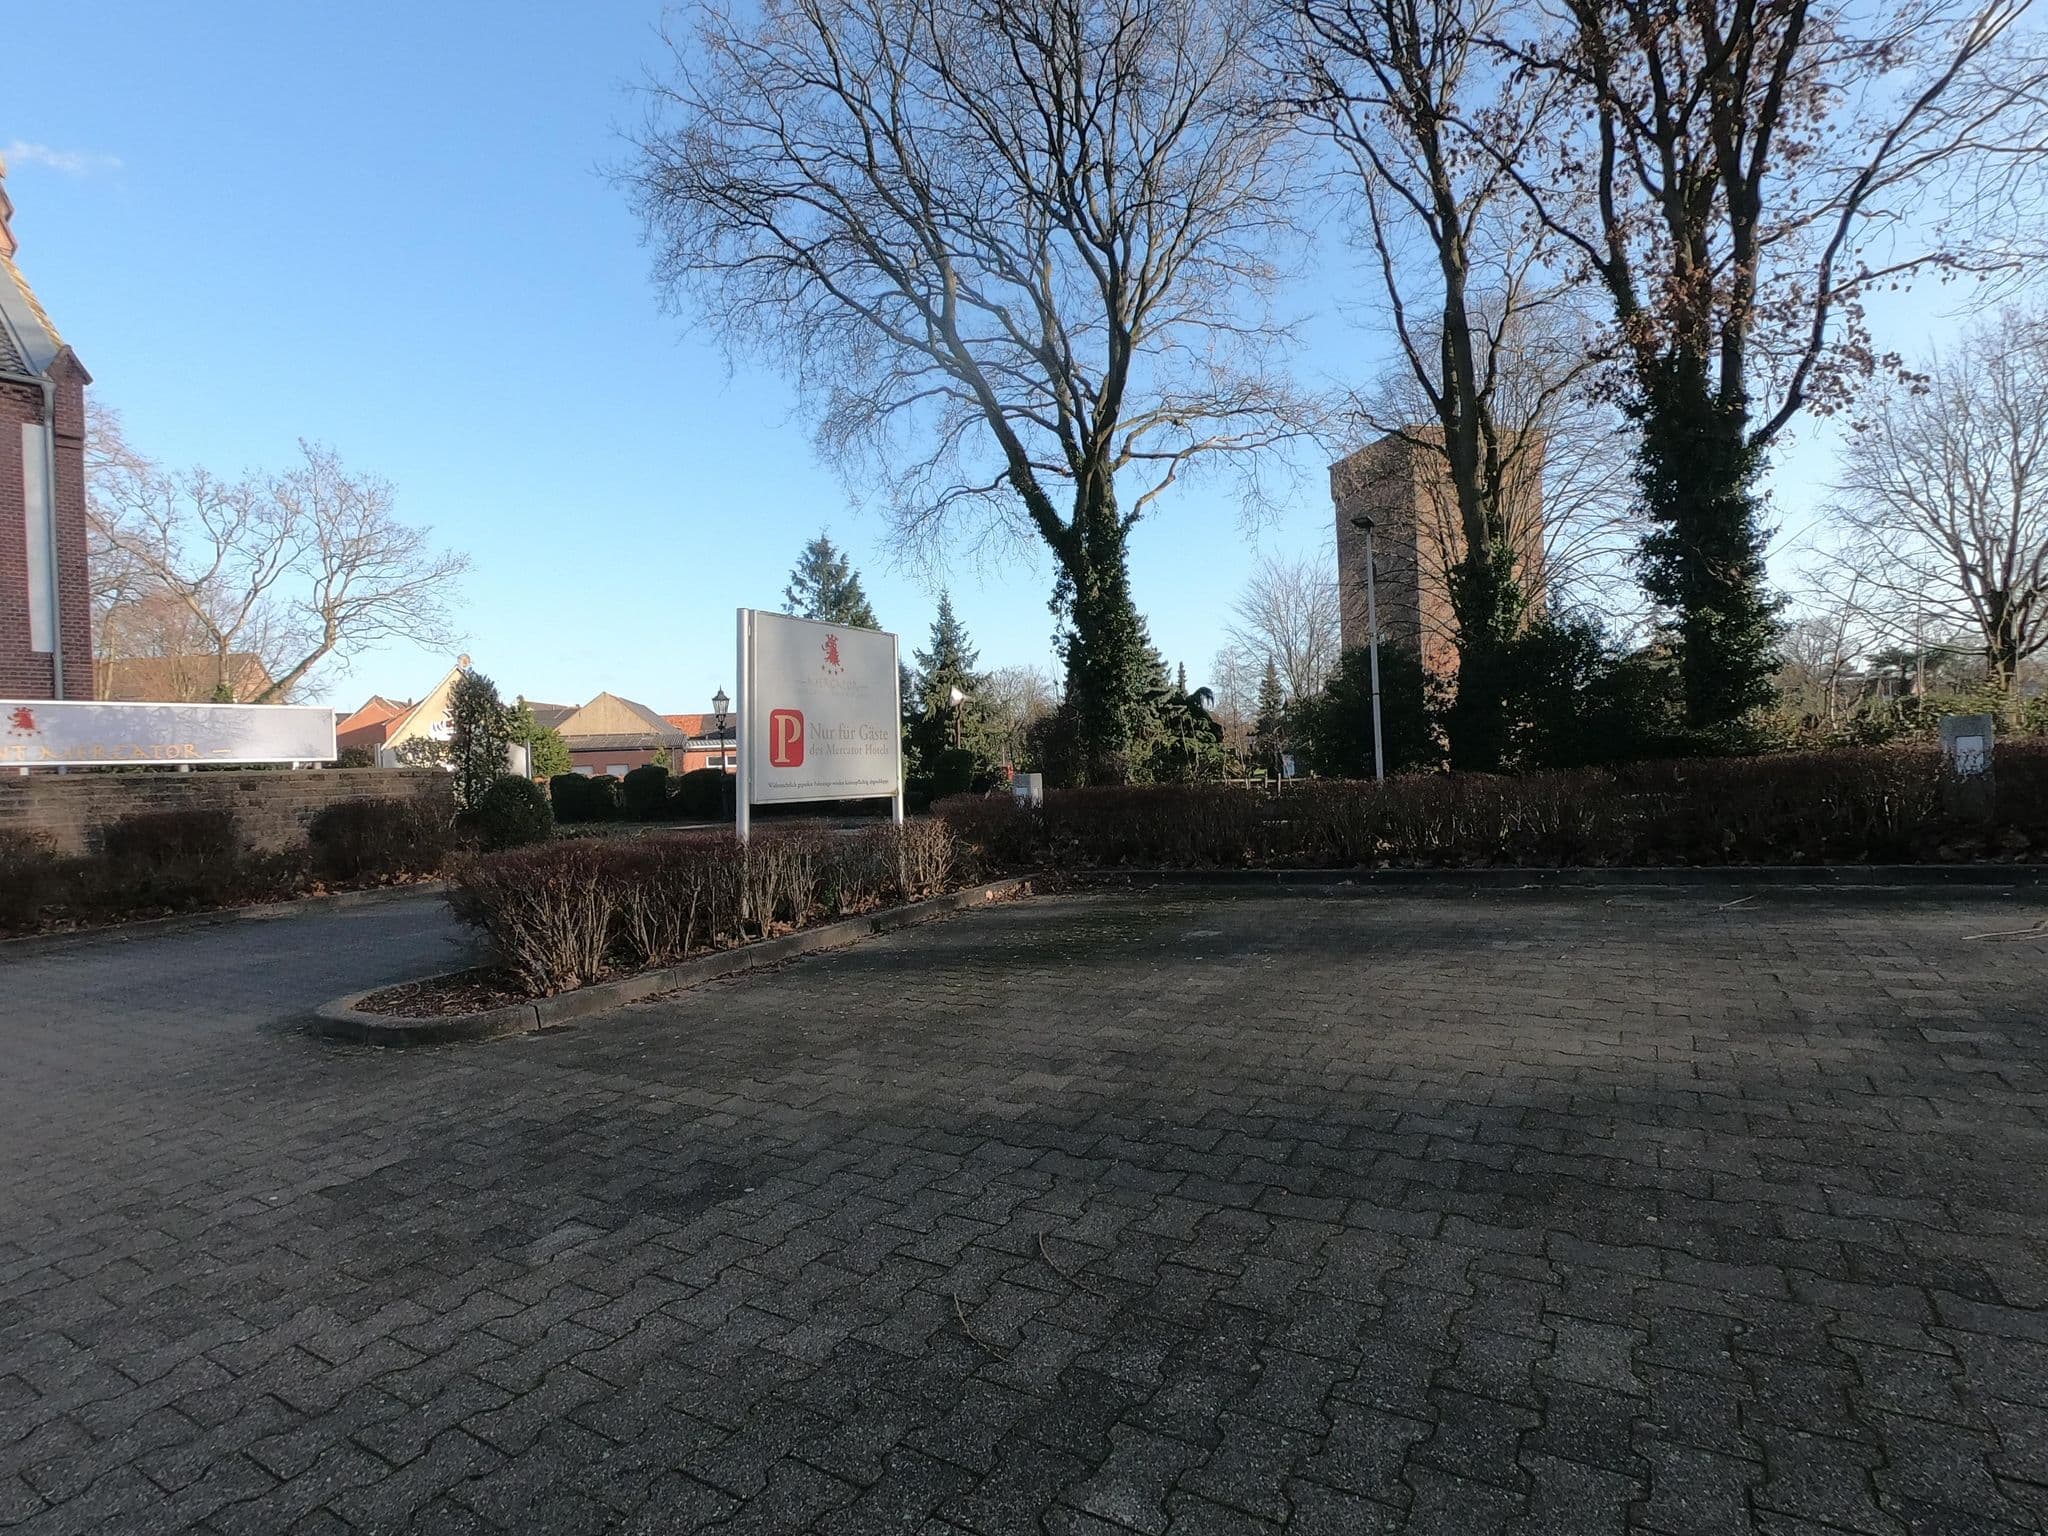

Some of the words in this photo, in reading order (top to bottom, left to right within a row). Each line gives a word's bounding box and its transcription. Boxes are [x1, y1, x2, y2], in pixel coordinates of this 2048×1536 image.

[774, 714, 801, 763] P
[808, 722, 837, 741] Nur
[839, 722, 856, 741] für
[859, 723, 889, 741] Gäste
[827, 743, 862, 756] Mercator
[865, 743, 889, 755] Hotels
